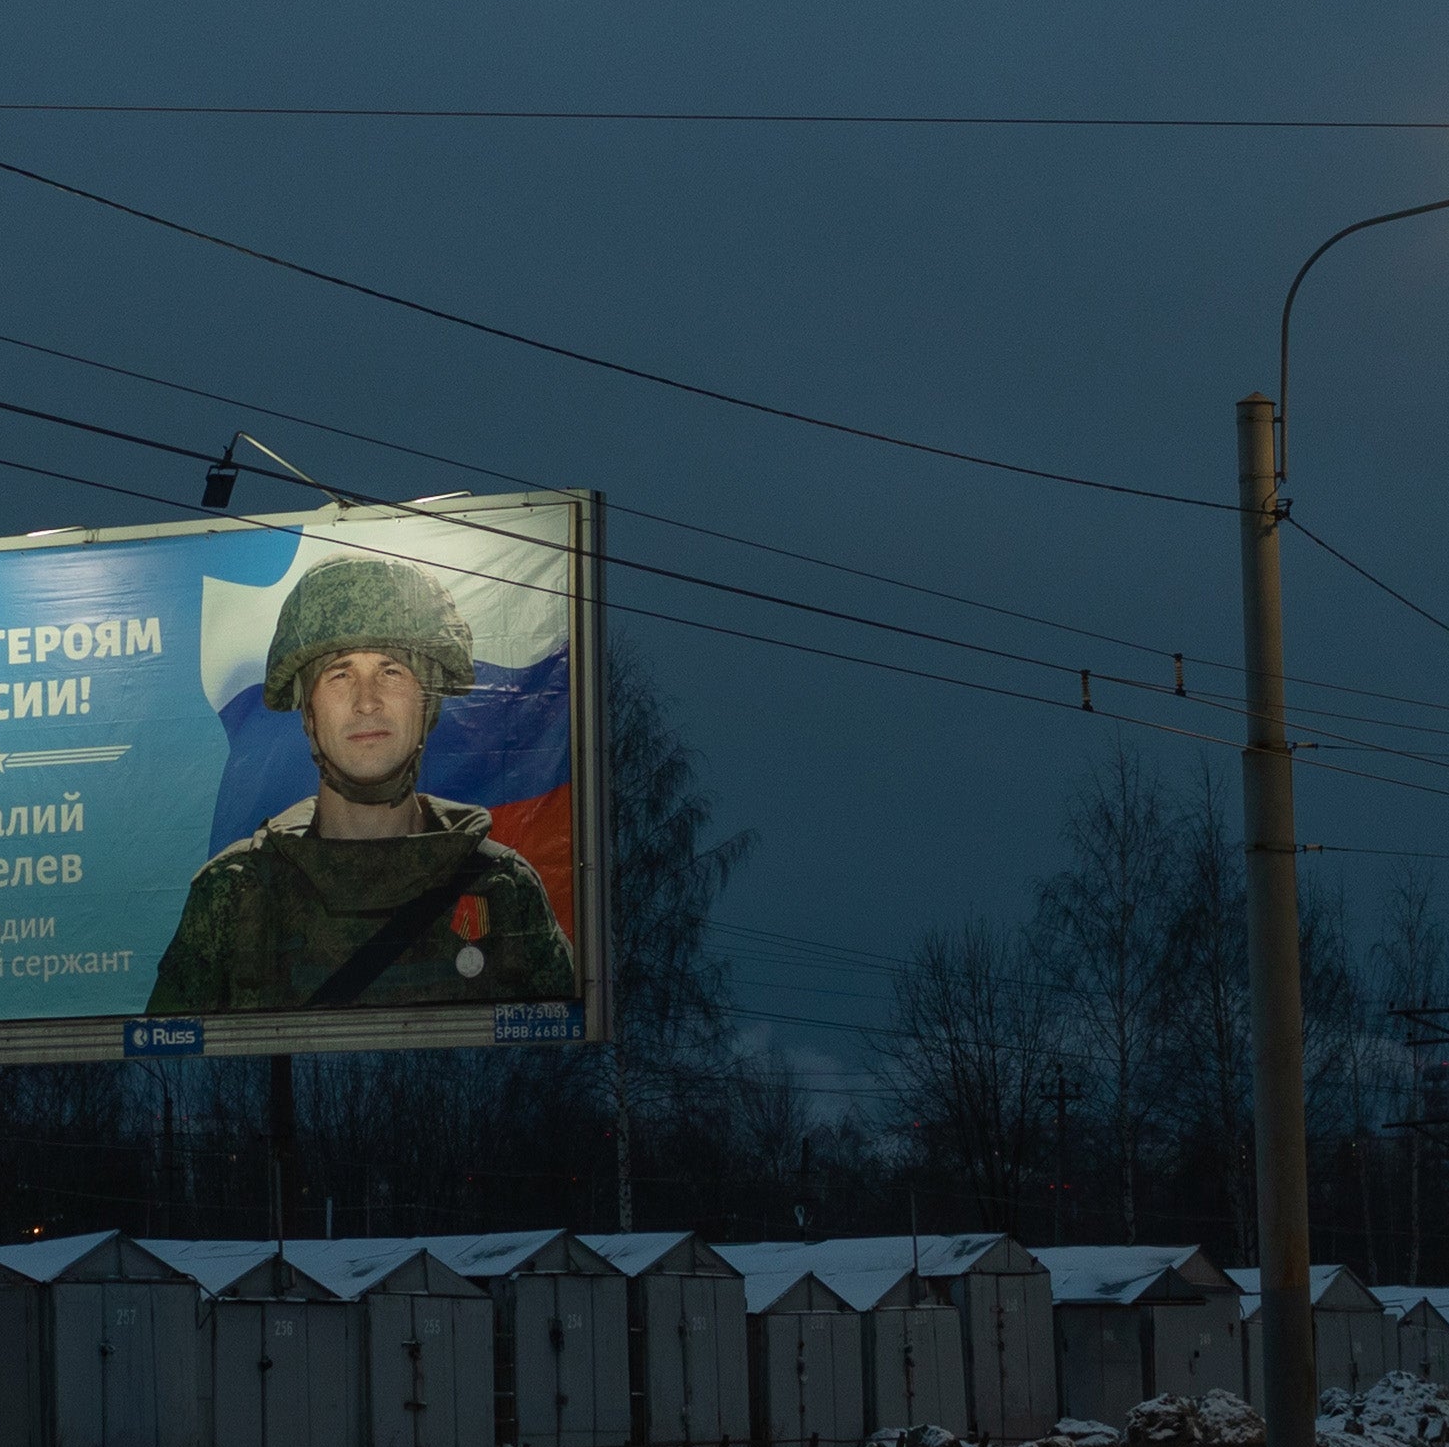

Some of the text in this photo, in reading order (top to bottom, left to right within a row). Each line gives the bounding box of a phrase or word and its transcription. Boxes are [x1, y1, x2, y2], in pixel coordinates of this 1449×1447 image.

[11, 950, 134, 983] сержант
[152, 1027, 196, 1045] Russ
[116, 1308, 136, 1325] 257
